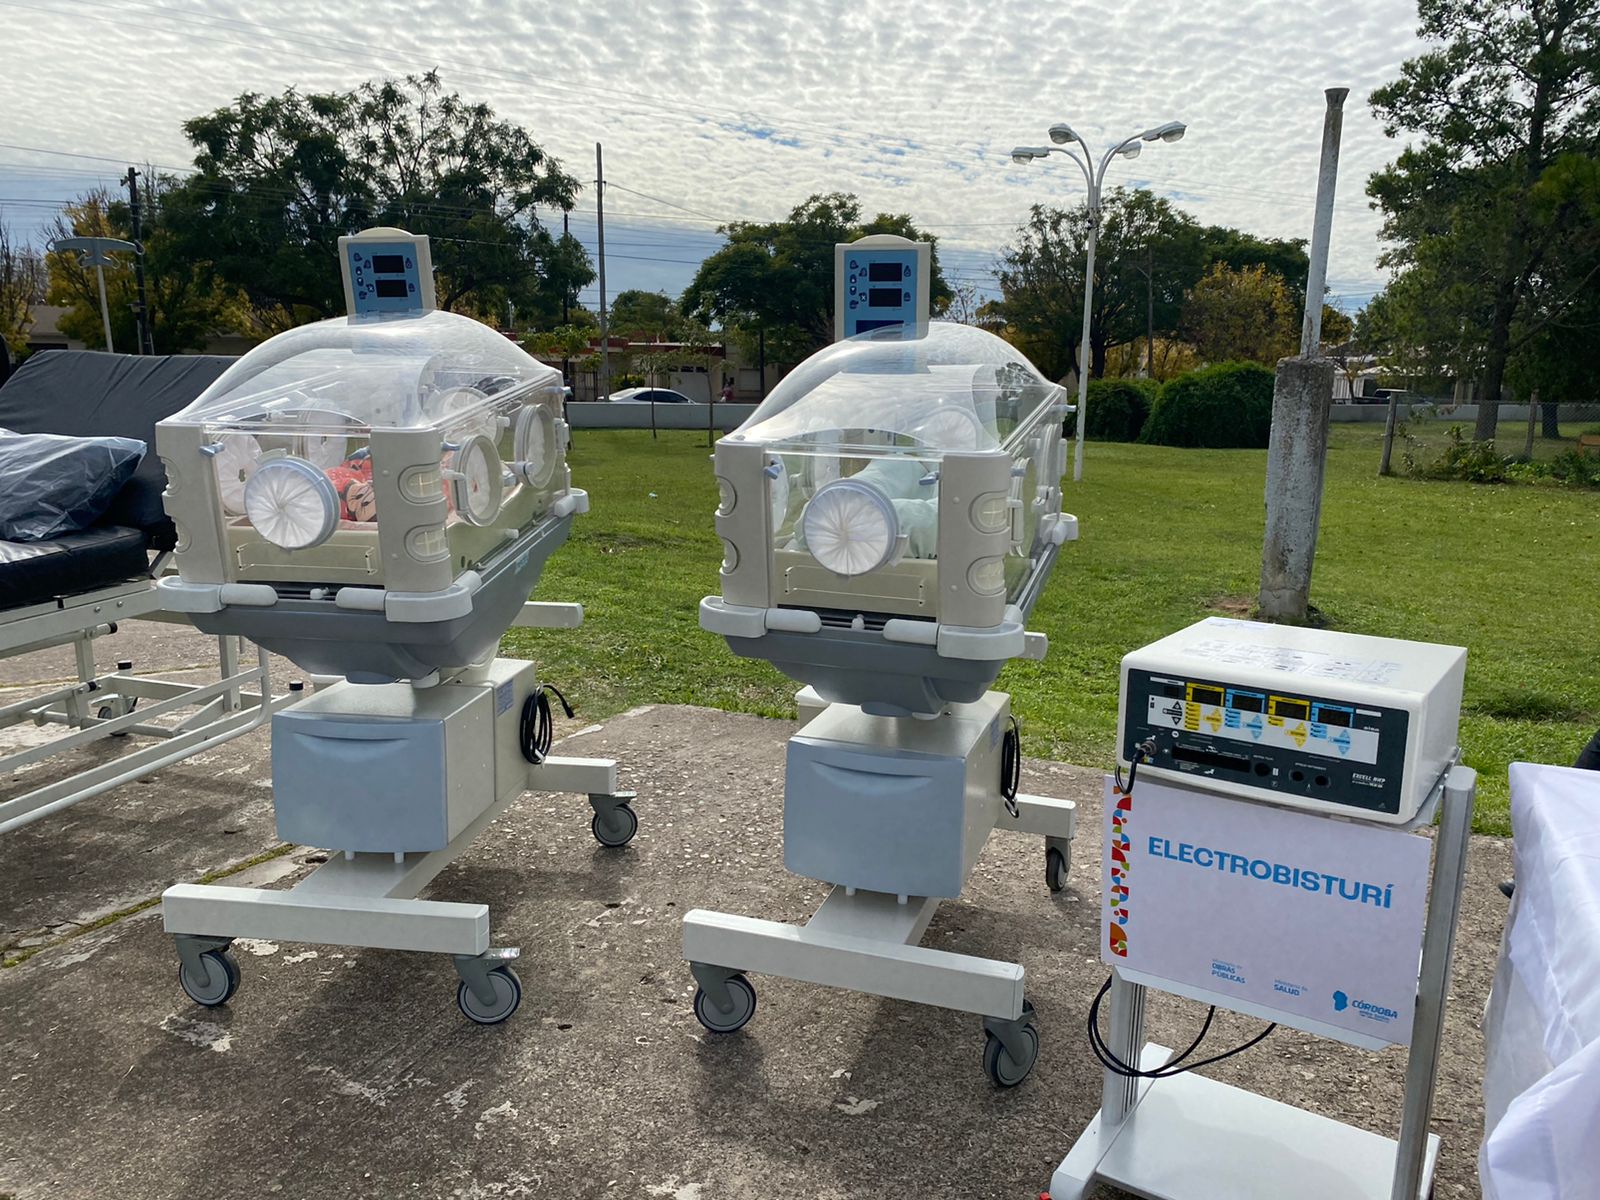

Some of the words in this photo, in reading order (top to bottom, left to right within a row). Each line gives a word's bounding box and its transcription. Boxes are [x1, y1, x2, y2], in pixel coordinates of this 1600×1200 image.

[1148, 836, 1395, 909] ELECTROBISTURÍ
[1211, 962, 1236, 974] OBRAS
[1273, 984, 1300, 996] SALUD
[1352, 1000, 1398, 1019] CÓRDOBA
